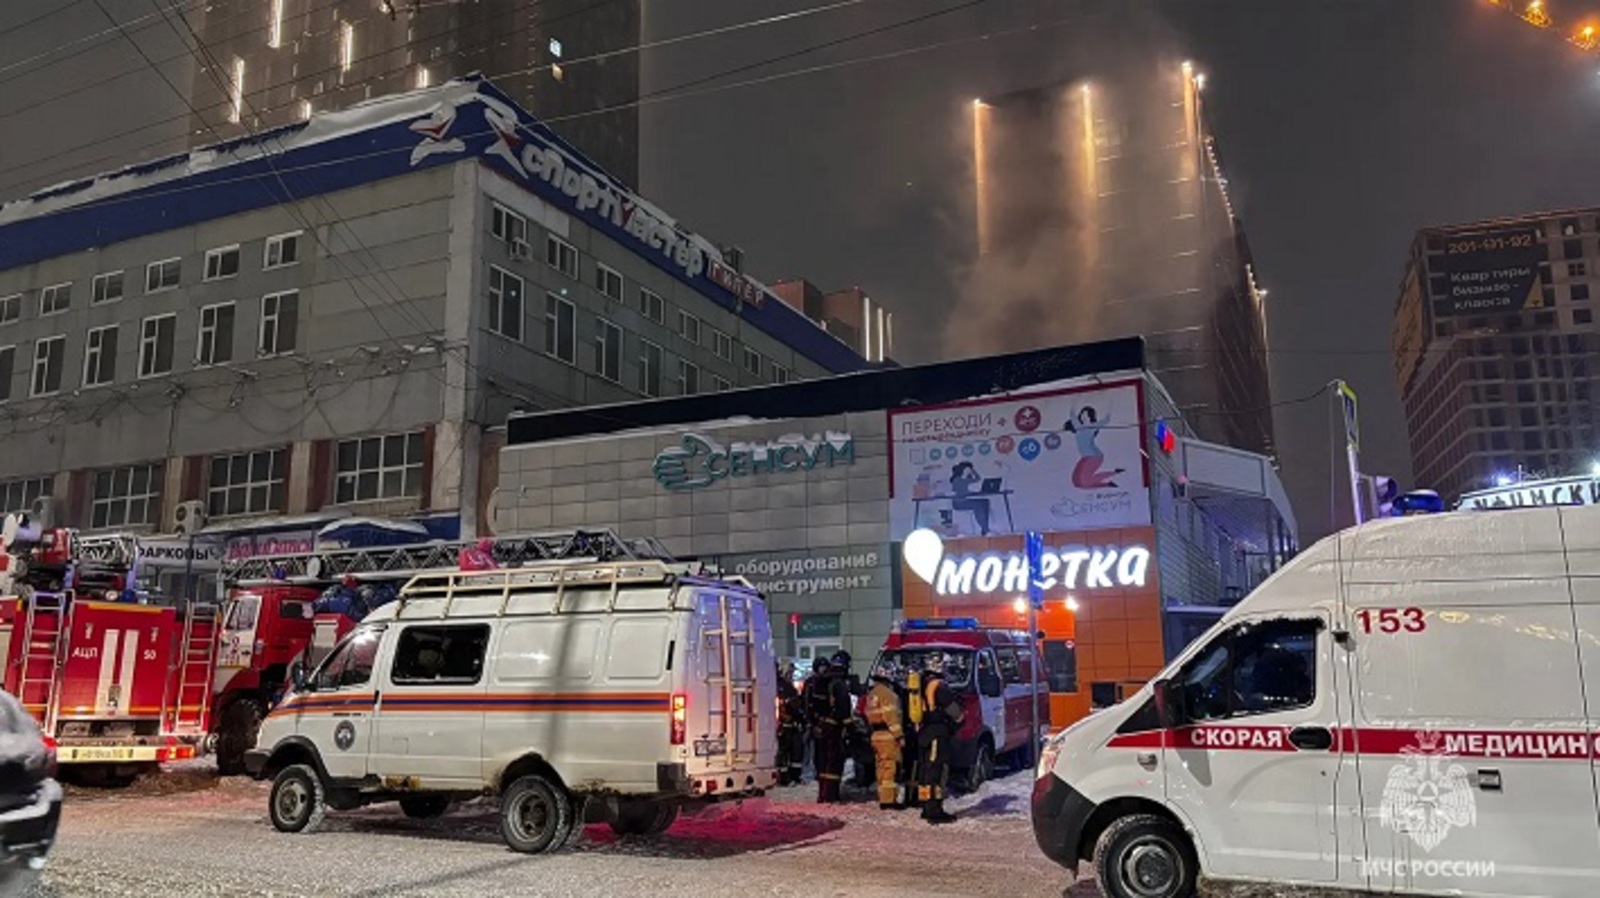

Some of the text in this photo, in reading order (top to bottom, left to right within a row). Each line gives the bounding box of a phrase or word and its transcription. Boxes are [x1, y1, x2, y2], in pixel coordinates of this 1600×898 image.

[902, 412, 992, 436] ПЕРЕХОДИ
[705, 434, 856, 481] СЕНСУМ
[735, 551, 879, 577] оборудование
[1357, 606, 1427, 635] 153
[72, 646, 99, 660] АЦП
[1190, 728, 1284, 748] СКОРАЯ
